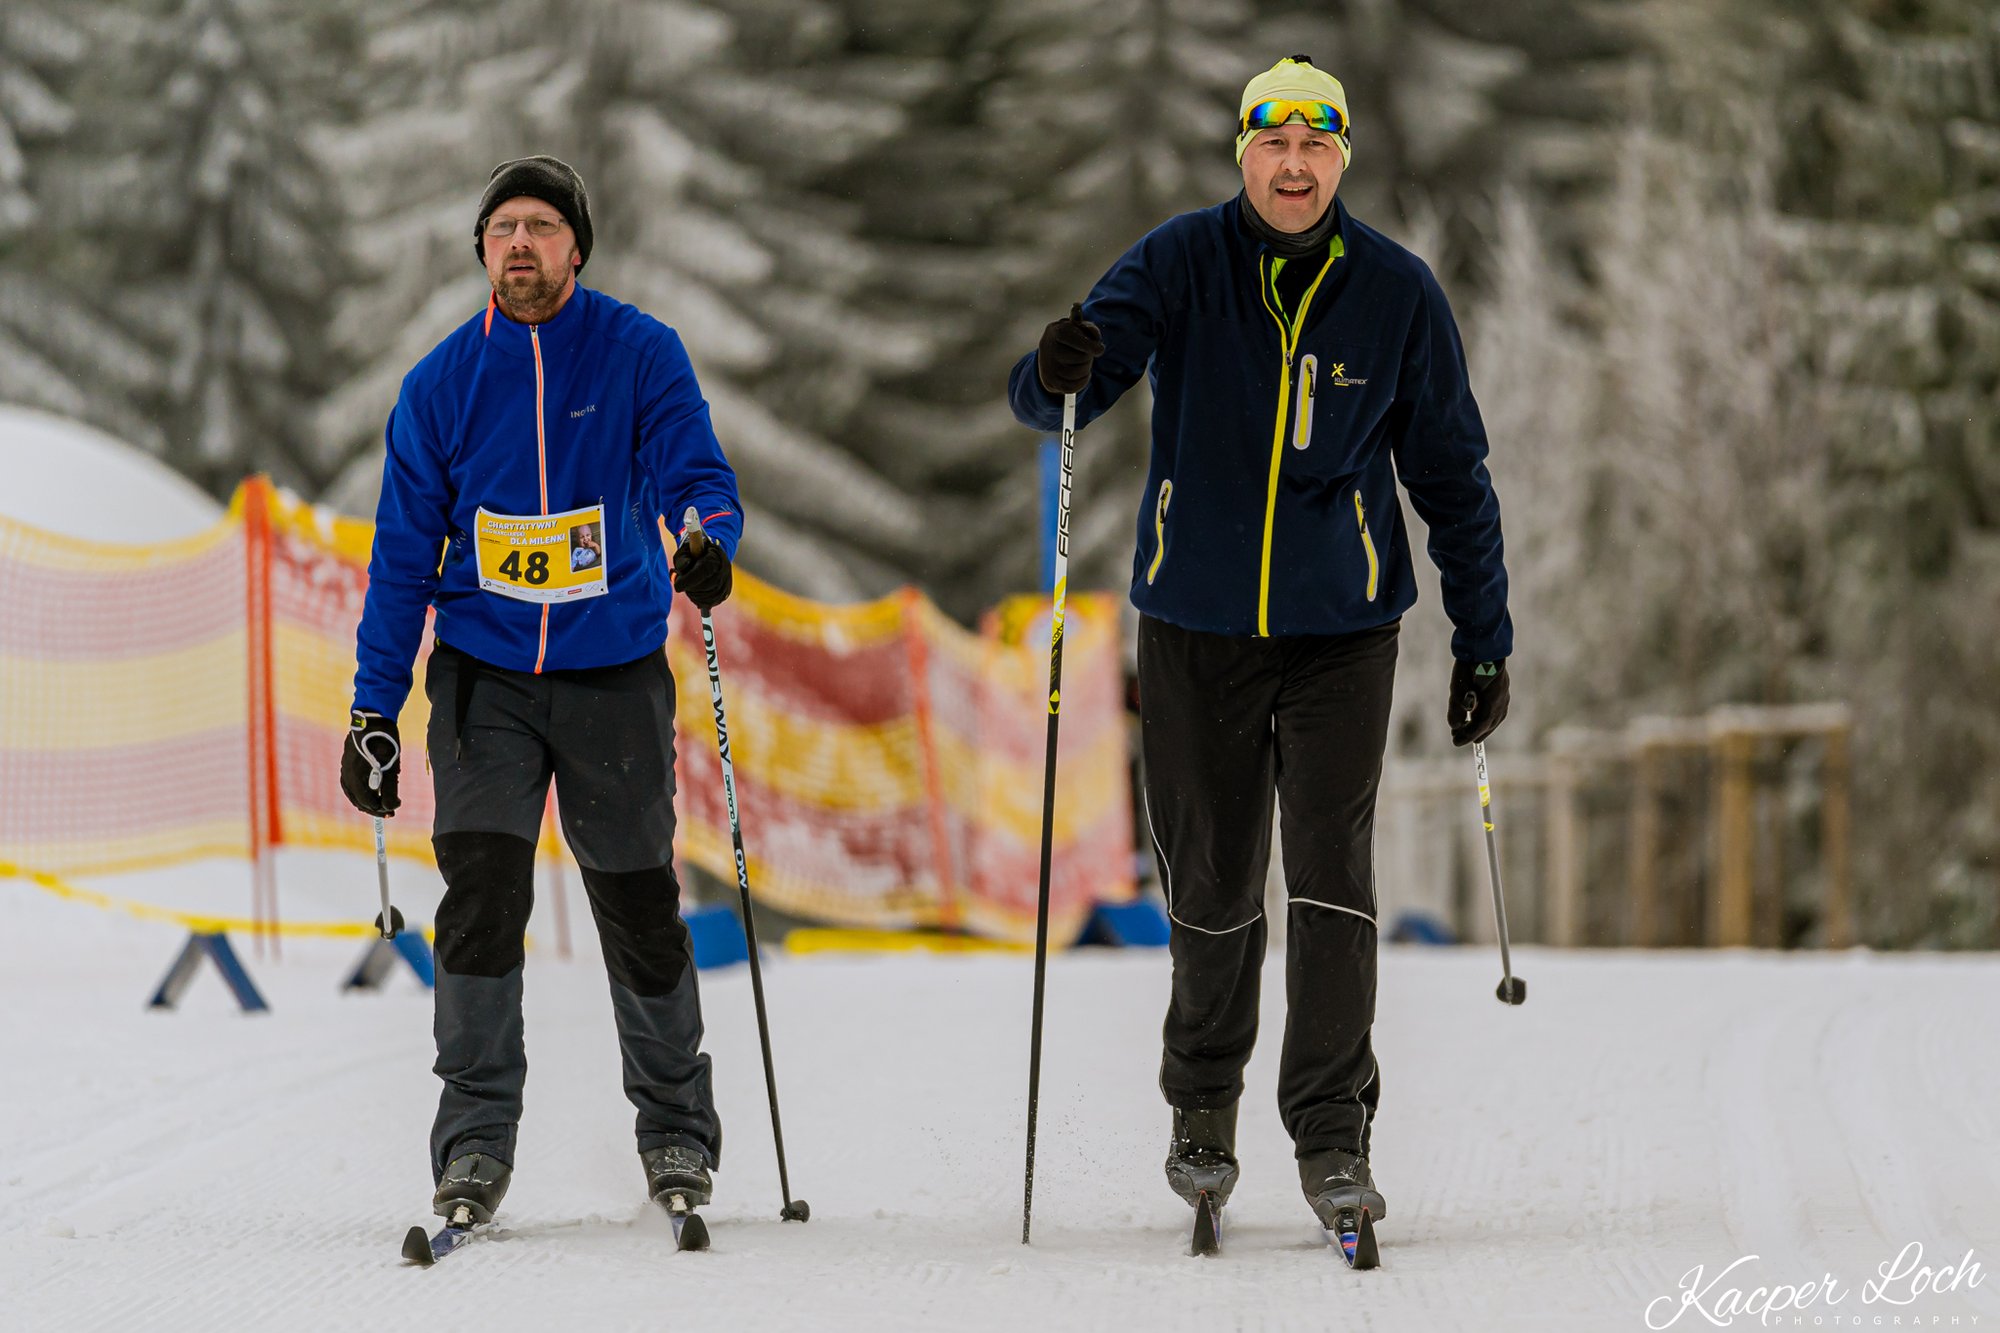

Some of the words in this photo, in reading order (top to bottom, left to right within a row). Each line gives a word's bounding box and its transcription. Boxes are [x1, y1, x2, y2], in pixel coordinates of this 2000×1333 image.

[1058, 428, 1075, 558] FISCHER
[487, 520, 558, 531] CHARYTATYWNY
[529, 533, 566, 545] MILENKI
[498, 550, 550, 585] 48
[735, 848, 748, 889] OW
